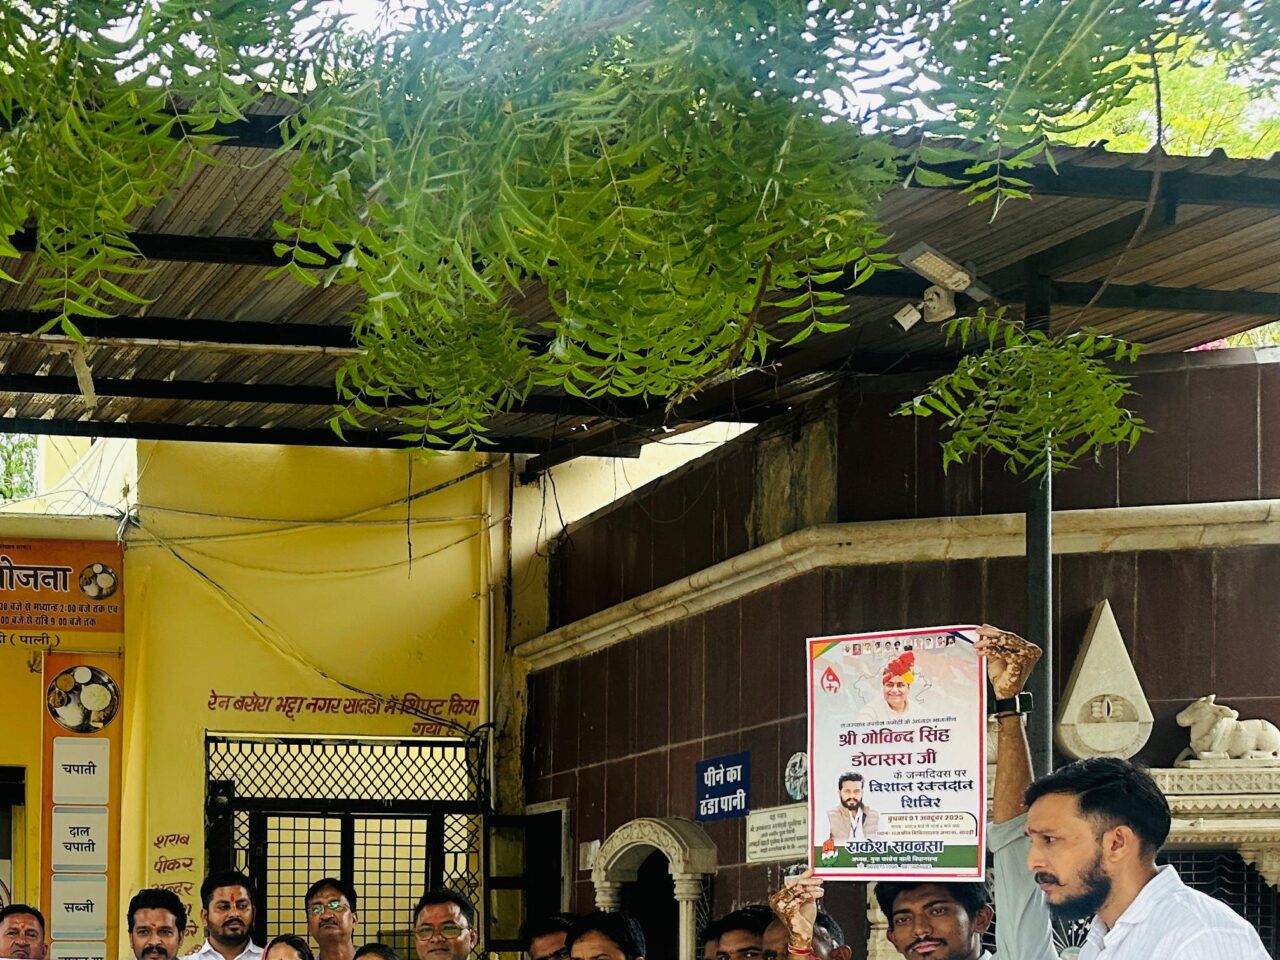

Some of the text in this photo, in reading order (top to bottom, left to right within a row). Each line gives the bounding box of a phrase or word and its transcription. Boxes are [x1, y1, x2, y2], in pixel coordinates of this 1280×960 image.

[10, 601, 22, 611] बजे
[25, 601, 31, 611] से
[78, 603, 90, 613] बजे
[92, 604, 105, 613] तक
[12, 614, 24, 624] बजे
[26, 614, 32, 624] से
[70, 615, 82, 626] बजे
[84, 618, 97, 626] तक
[233, 691, 274, 712] बसेरा
[306, 697, 342, 713] नगर
[448, 693, 480, 715] किया
[412, 722, 441, 735] गया
[839, 724, 951, 747] श्री गोविन्द सिंह
[851, 748, 938, 767] डोटासरा जी
[62, 761, 96, 775] चपाती
[954, 768, 968, 779] पर
[704, 764, 742, 787] पीने का
[869, 779, 974, 793] विशाल रक्तदान
[700, 789, 746, 815] ठंडा पानी
[901, 795, 941, 808] शिविर
[69, 825, 91, 837] दाल
[62, 840, 95, 853] चपाती
[153, 834, 190, 848] शराब
[845, 838, 888, 853] राकेश
[154, 855, 195, 874] पीकर
[64, 901, 94, 914] सब्जी
